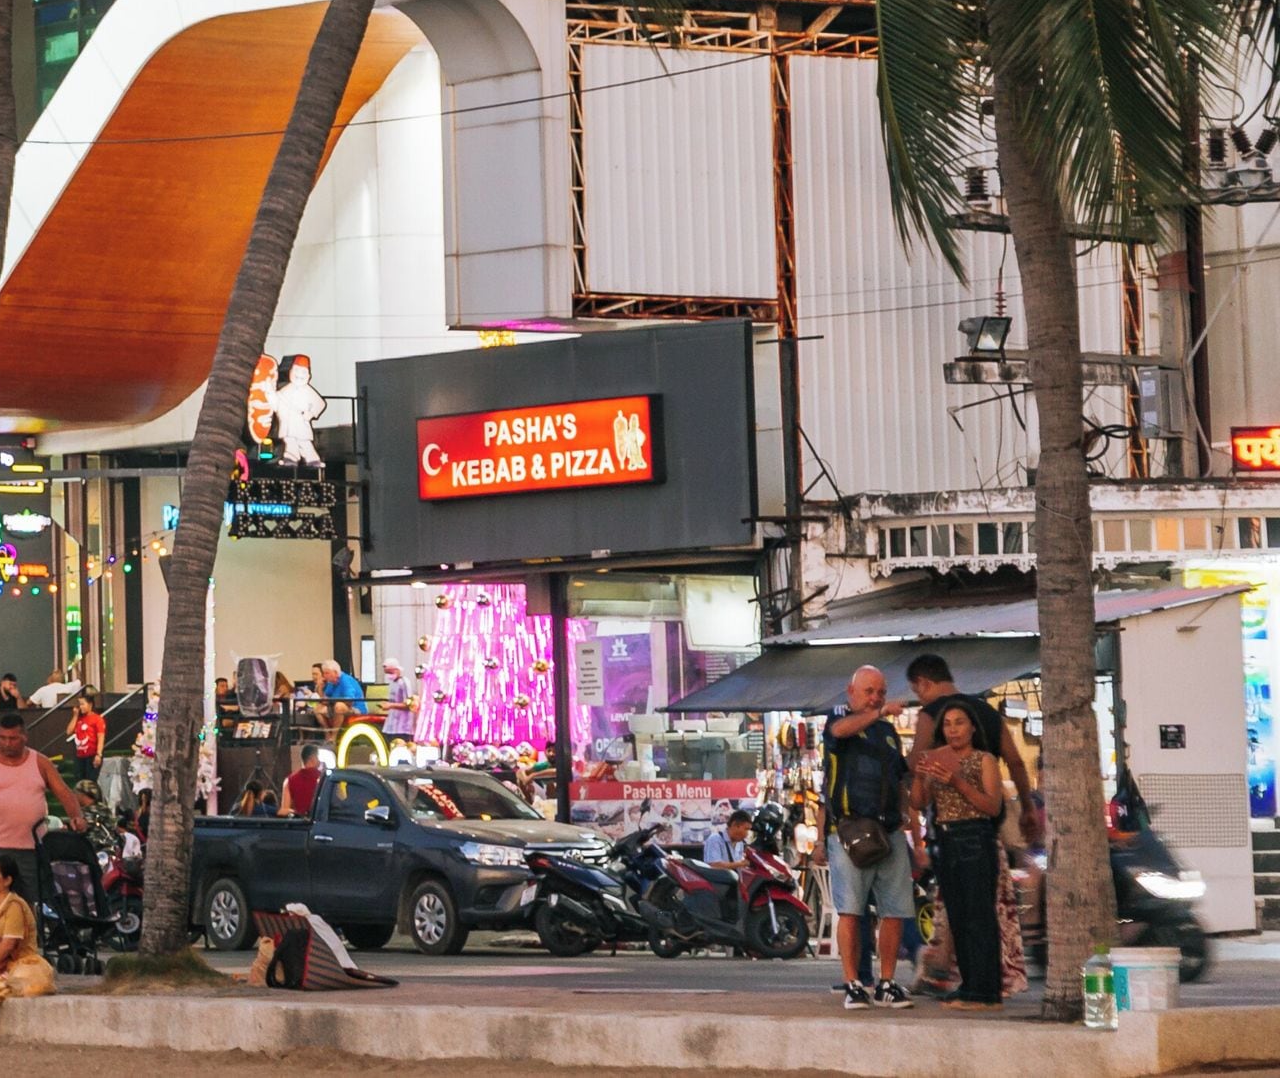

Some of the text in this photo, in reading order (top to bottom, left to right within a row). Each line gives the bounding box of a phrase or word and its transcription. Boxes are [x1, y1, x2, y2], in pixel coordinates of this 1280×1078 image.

[484, 413, 578, 447] PASHA'S
[451, 447, 615, 488] KEBAB & PIZZA
[237, 479, 338, 508] KEBAB
[623, 783, 712, 800] Pasha's Menu
